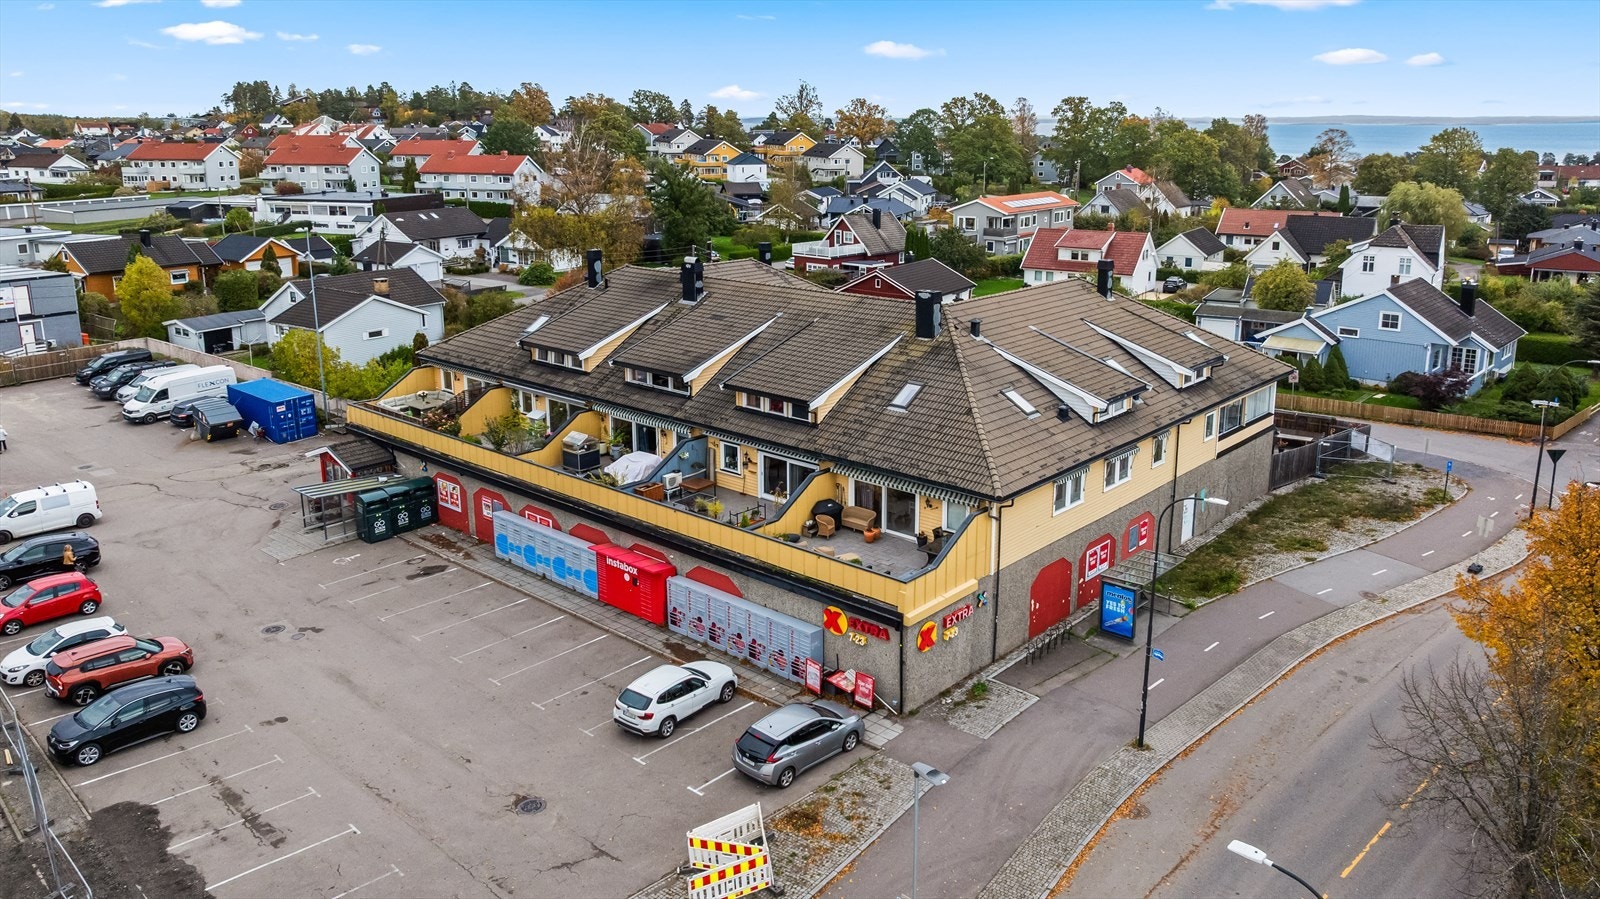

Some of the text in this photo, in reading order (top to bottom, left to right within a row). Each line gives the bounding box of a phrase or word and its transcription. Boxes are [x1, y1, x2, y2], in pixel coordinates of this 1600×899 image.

[198, 378, 229, 388] FLEXCON
[606, 555, 638, 575] instabox
[944, 603, 974, 628] EXTRA
[848, 616, 890, 641] EXTRA
